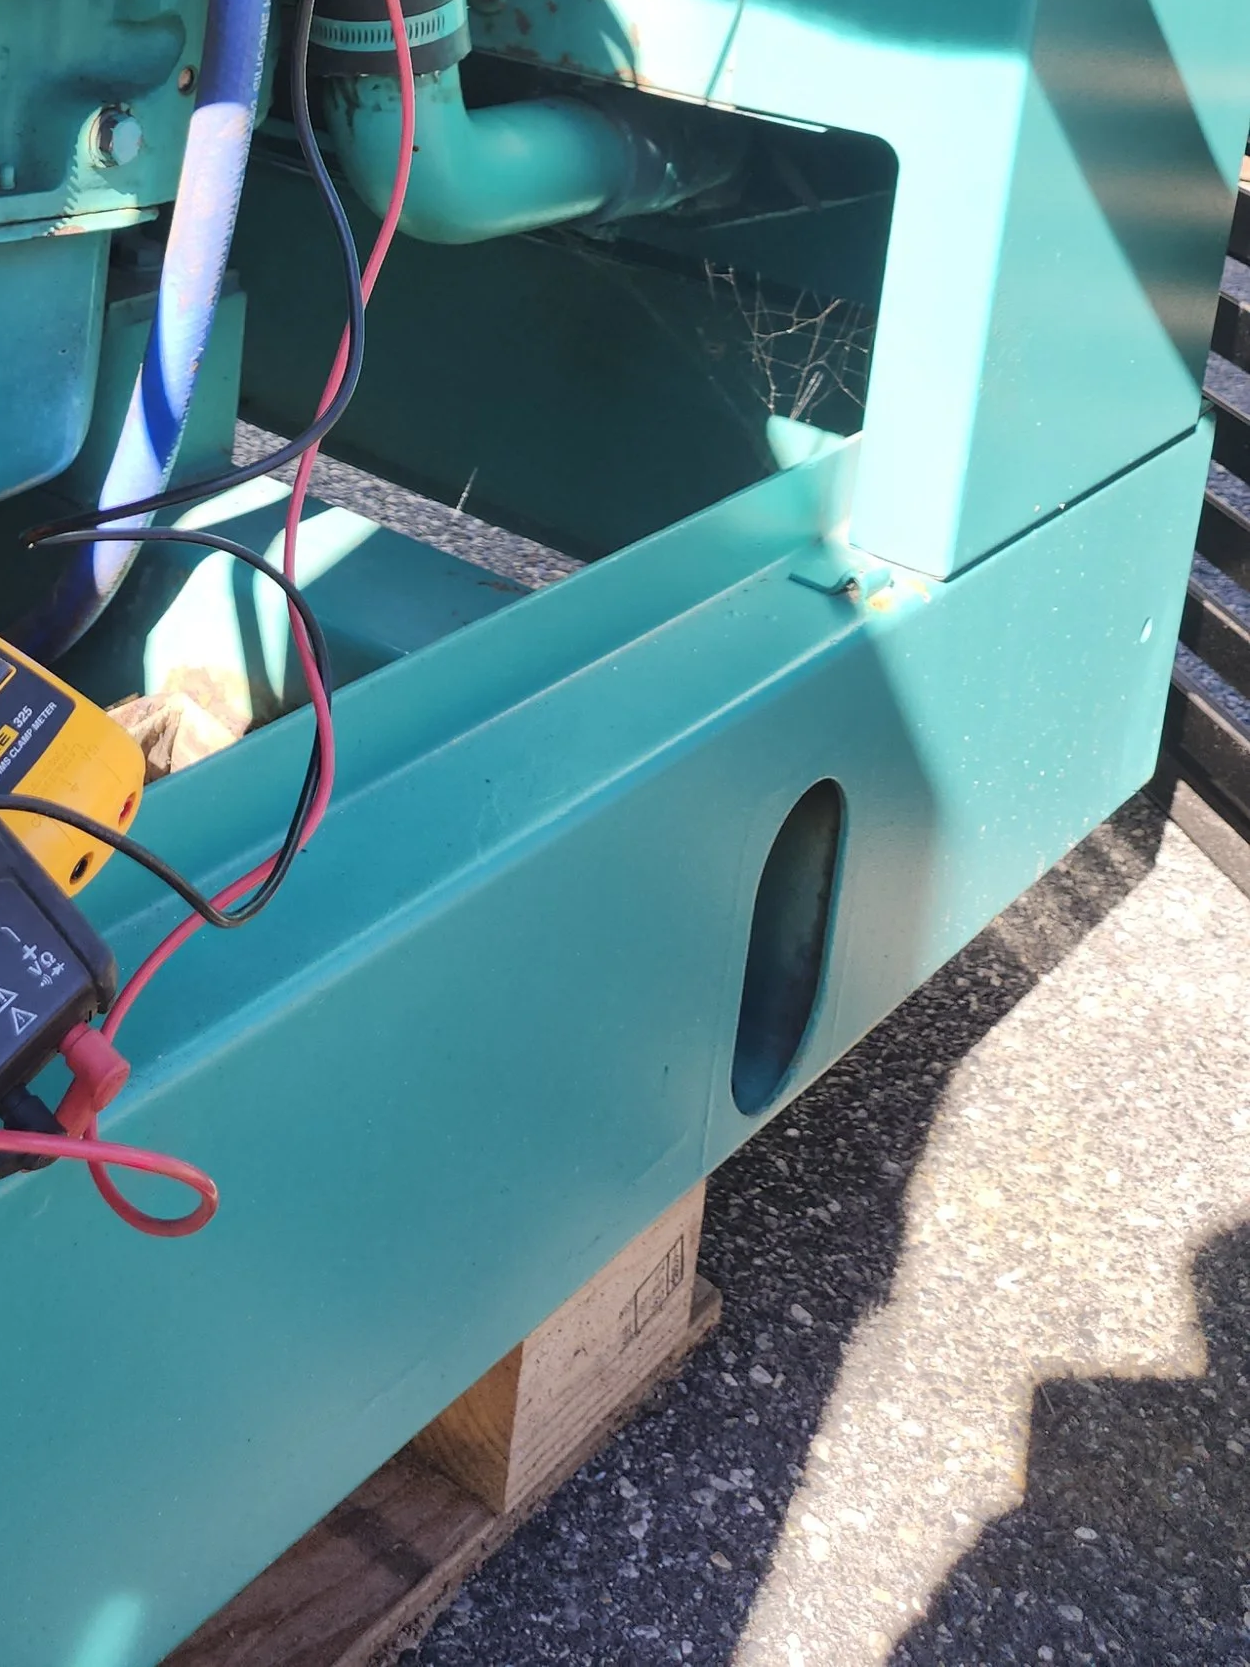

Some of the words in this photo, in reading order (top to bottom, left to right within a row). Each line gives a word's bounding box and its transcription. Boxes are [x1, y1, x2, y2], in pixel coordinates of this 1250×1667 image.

[9, 729, 33, 758] CLAMP
[31, 701, 57, 730] METER
[13, 705, 33, 728] 325
